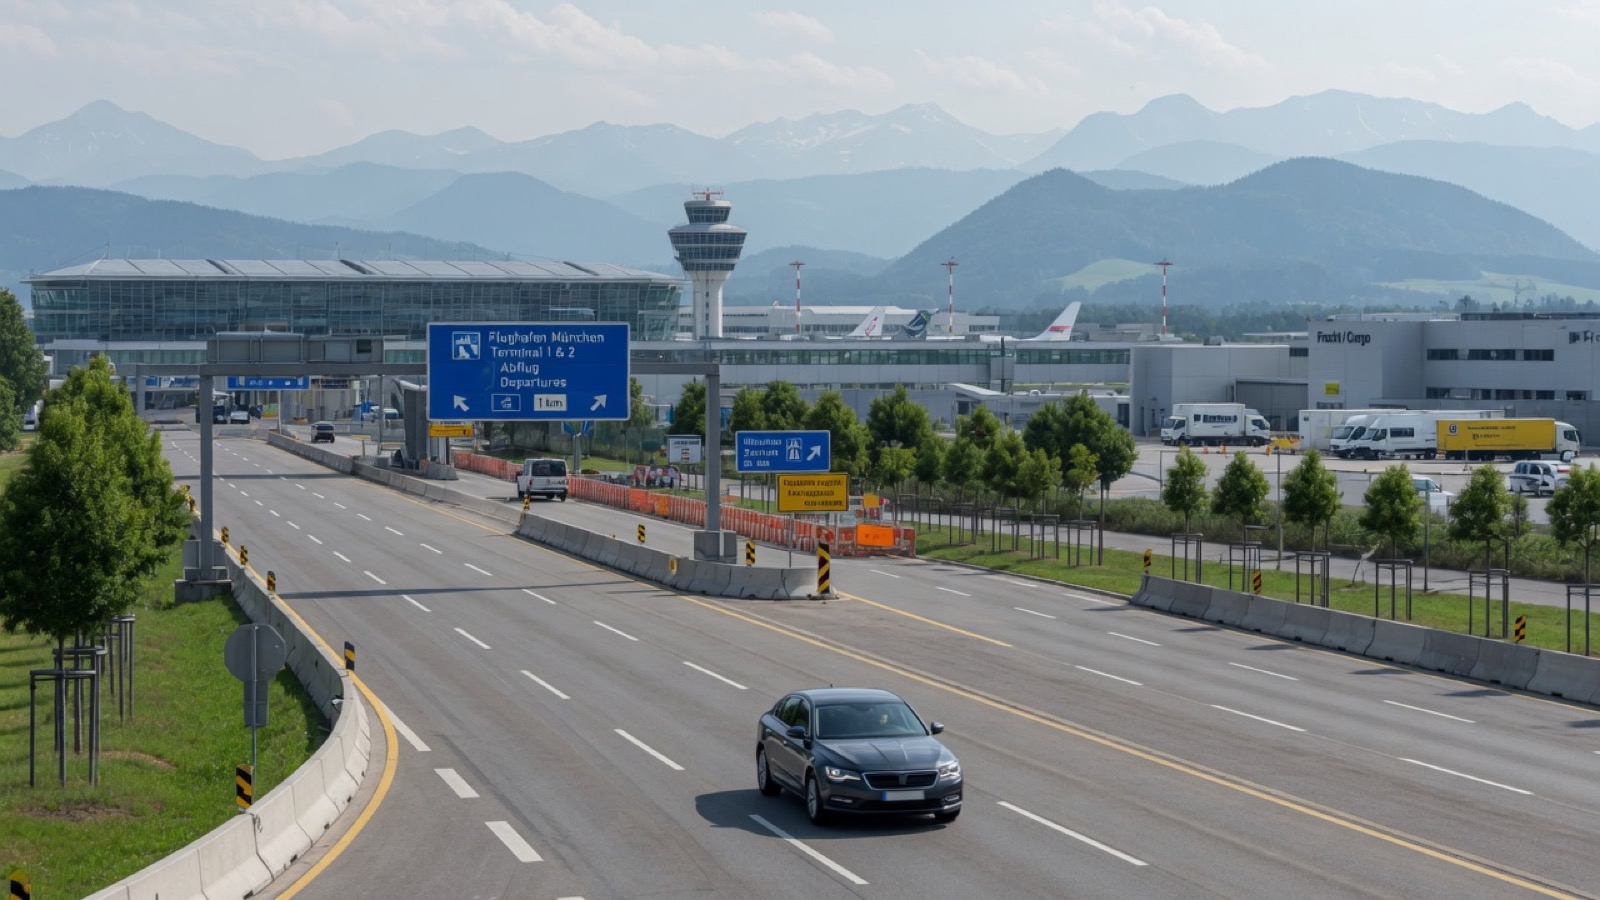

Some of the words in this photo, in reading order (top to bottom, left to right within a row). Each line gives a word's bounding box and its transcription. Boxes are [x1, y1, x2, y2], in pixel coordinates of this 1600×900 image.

[488, 331, 547, 346] Flughafen
[551, 331, 605, 343] München
[490, 346, 543, 358] Terminal
[555, 346, 565, 358] &
[568, 346, 575, 358] 2
[500, 362, 540, 375] Abflug
[500, 377, 567, 390] Departures
[545, 398, 564, 407] km
